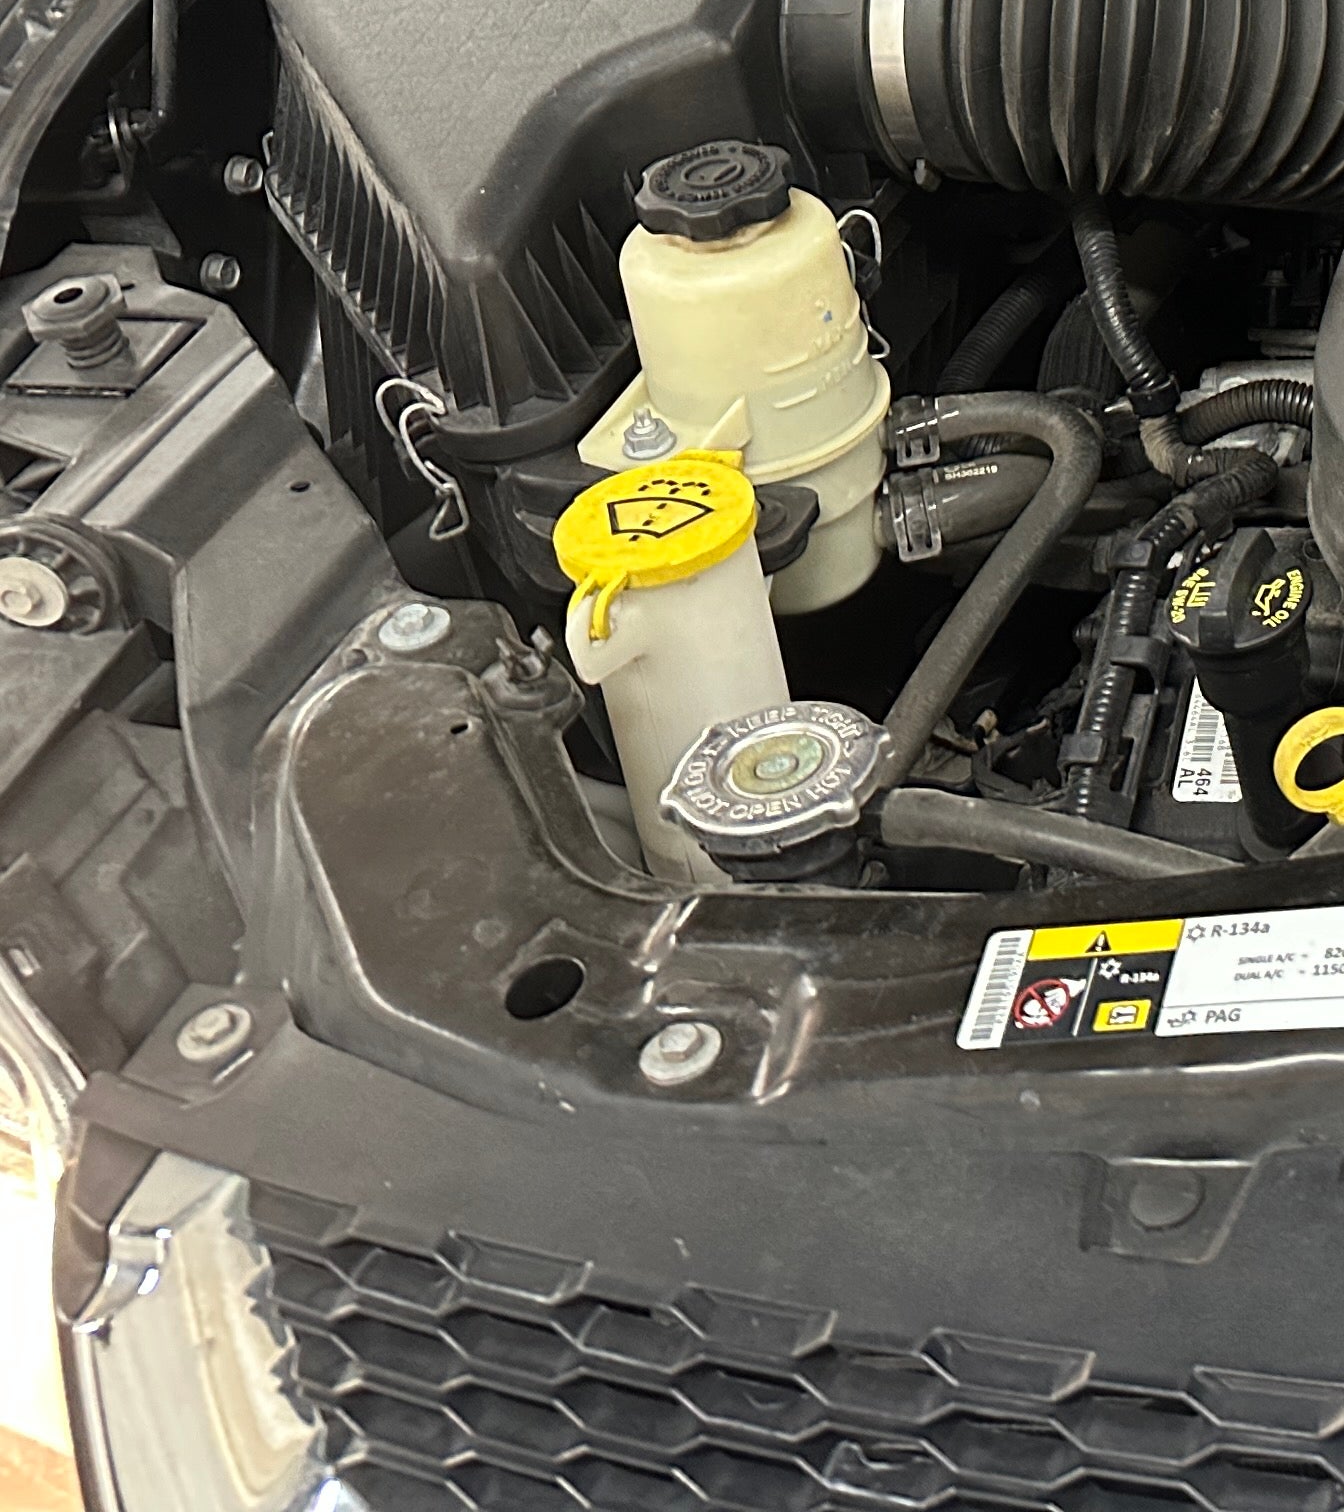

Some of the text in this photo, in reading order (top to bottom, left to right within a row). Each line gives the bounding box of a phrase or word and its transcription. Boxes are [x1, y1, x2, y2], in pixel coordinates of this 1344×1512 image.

[1262, 569, 1305, 628] ENGINE OIL
[728, 706, 796, 739] KEEP
[1177, 768, 1195, 788] AL
[1193, 768, 1213, 796] 464
[686, 787, 731, 815] NOT
[729, 794, 801, 820] OPEN
[805, 765, 851, 800] HOT
[1210, 921, 1271, 938] R-134a
[1204, 1007, 1242, 1025] PAG
